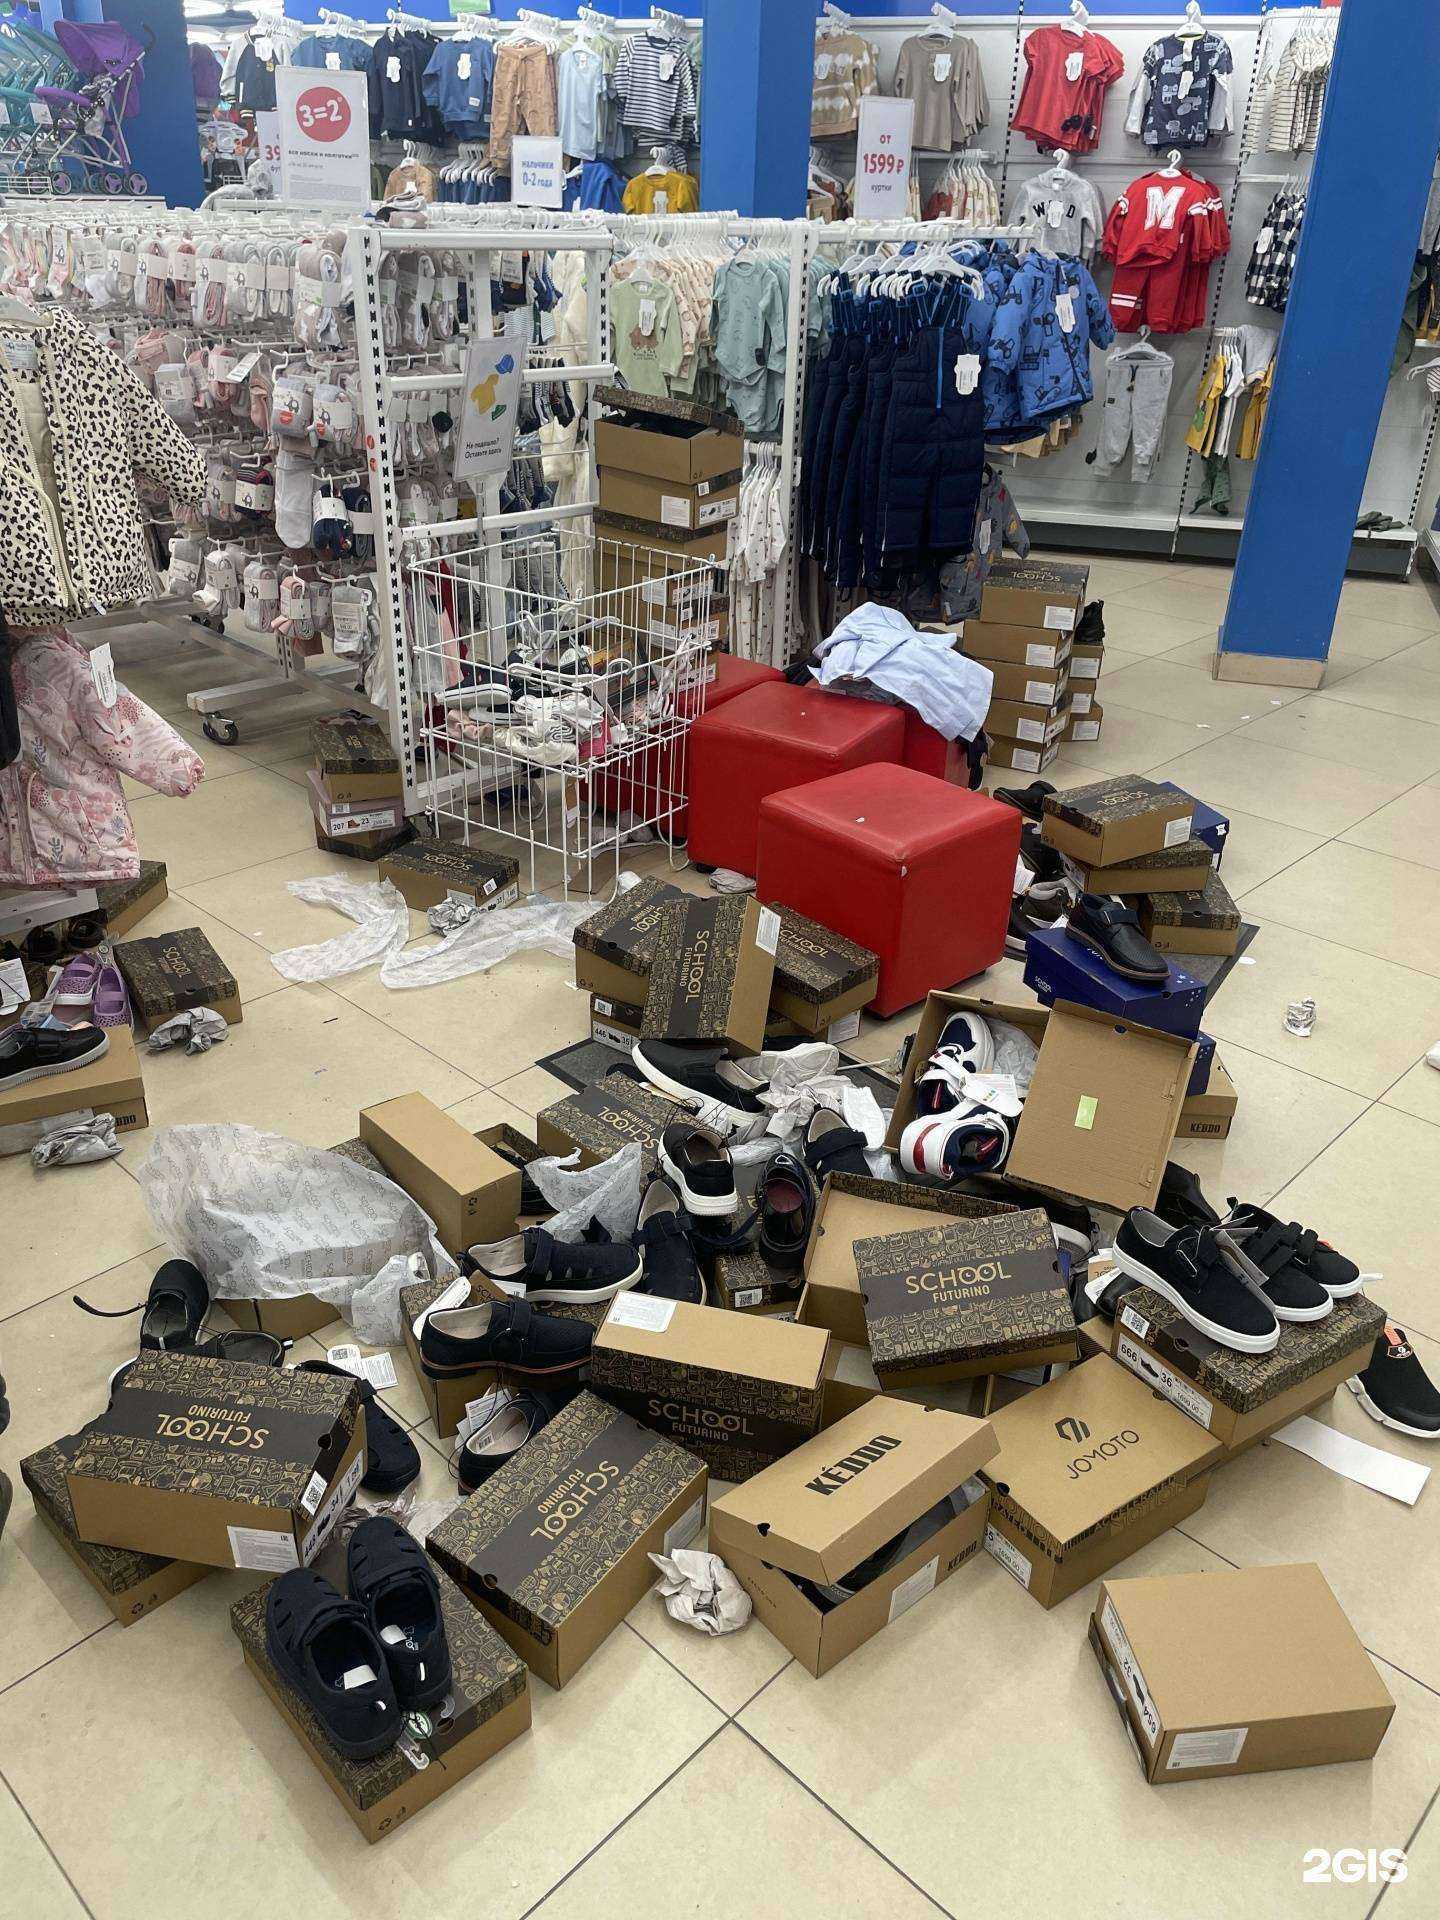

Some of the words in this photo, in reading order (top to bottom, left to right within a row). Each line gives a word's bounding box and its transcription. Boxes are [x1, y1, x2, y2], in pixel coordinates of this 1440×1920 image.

[880, 134, 891, 144] от
[1145, 186, 1186, 230] M
[780, 929, 829, 958] CHOOL
[679, 947, 693, 987] FUTURINO
[685, 930, 710, 1003] SCHOOL
[598, 1106, 660, 1149] SCHOOL
[905, 1262, 1012, 1295] SCHOOL
[932, 1284, 990, 1304] FUTURINO
[1120, 1343, 1138, 1362] 666
[1160, 1372, 1173, 1388] 36
[156, 1413, 270, 1450] SCHOOL
[188, 1404, 251, 1424] FUTURINO
[648, 1400, 755, 1437] SCHOOL
[672, 1422, 729, 1441] FUTURINO
[1067, 1430, 1140, 1480] JOMOTO
[530, 1460, 619, 1540] SCHOOL
[537, 1469, 585, 1514] FUTURINO
